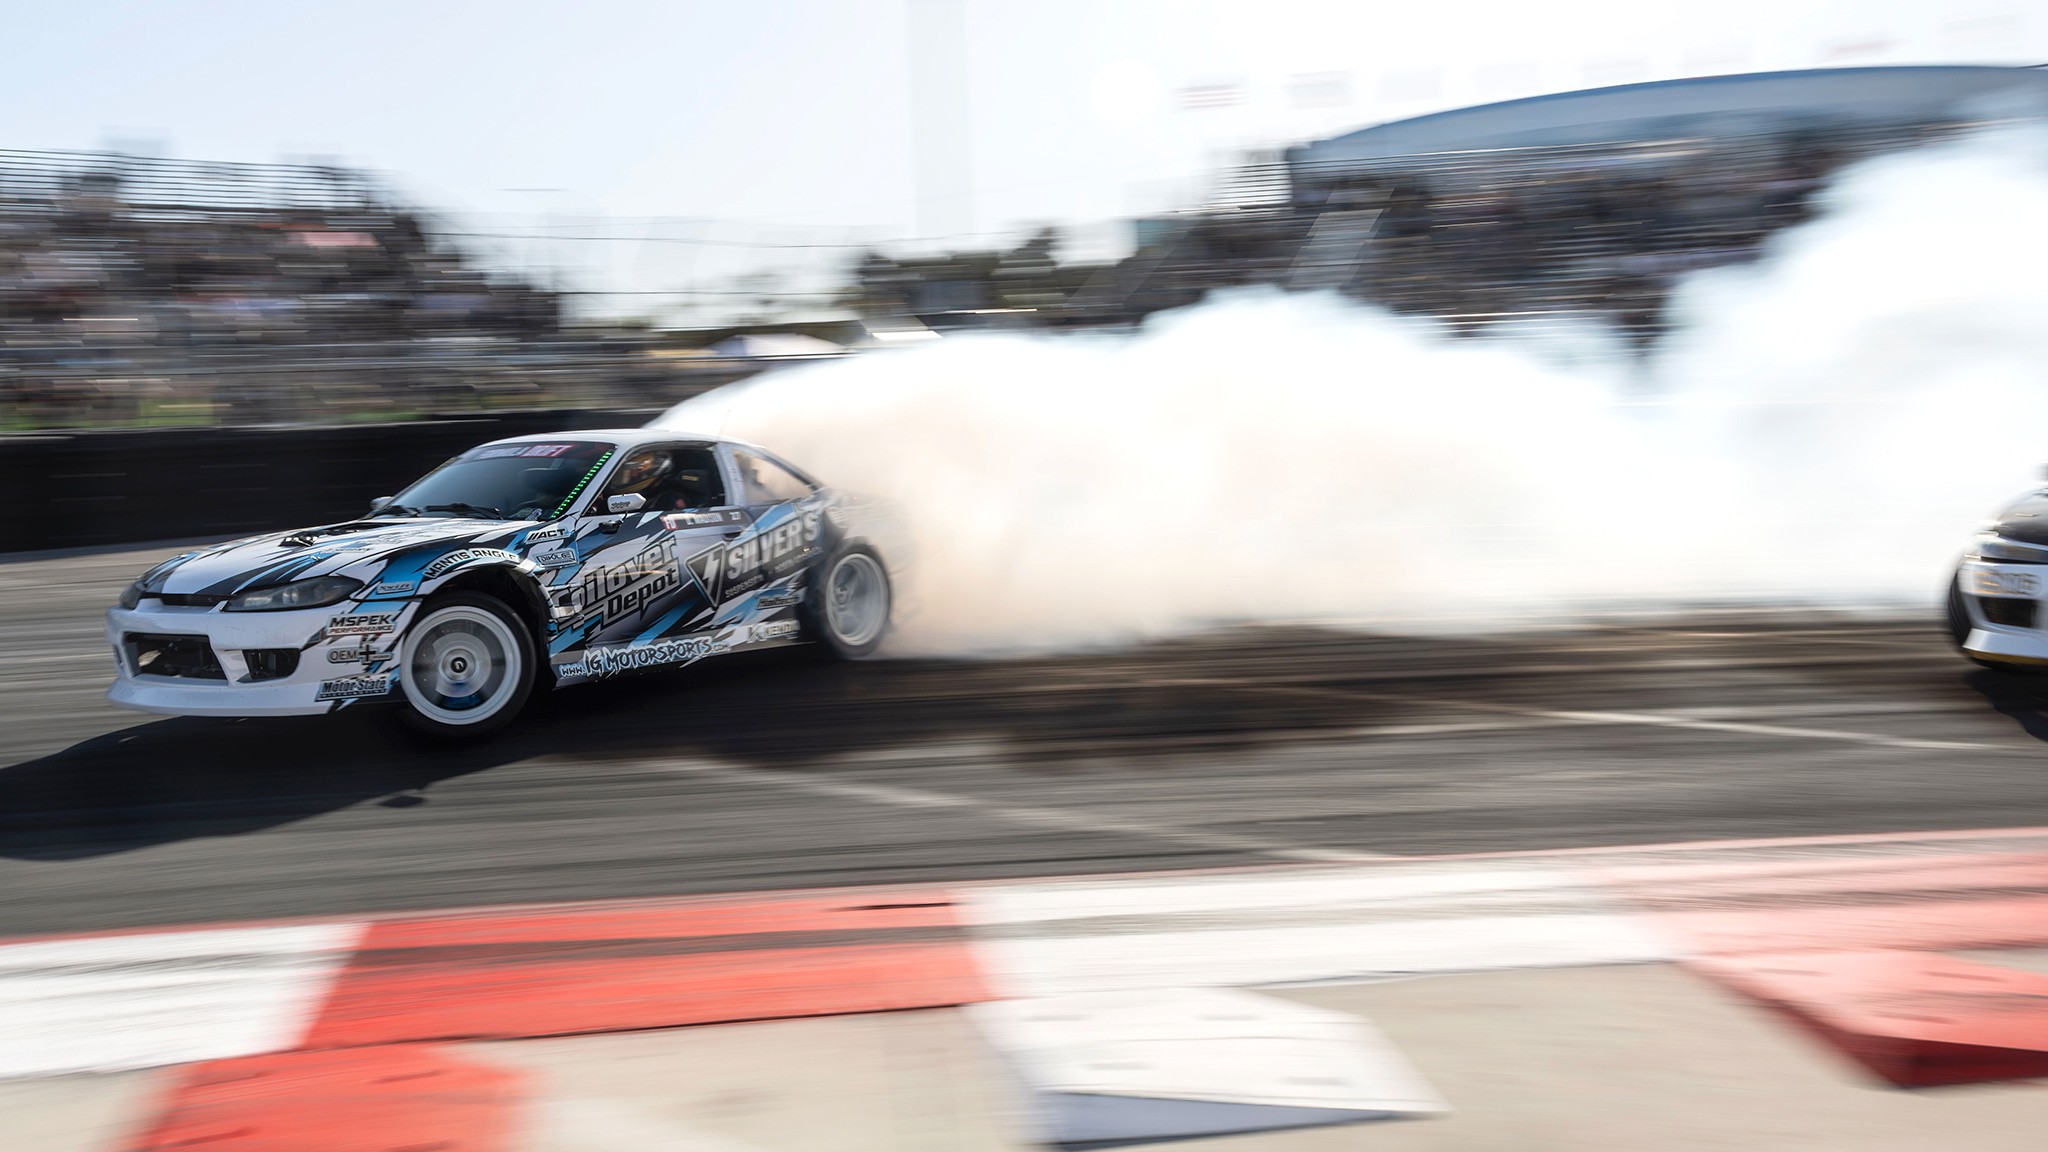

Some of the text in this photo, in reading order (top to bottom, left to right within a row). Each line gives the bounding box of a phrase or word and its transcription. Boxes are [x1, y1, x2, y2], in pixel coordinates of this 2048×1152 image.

[424, 549, 517, 577] MANTIS ANGLE
[550, 534, 678, 617] Coilover
[607, 567, 678, 621] Depot
[328, 614, 392, 628] MSPEK
[328, 625, 393, 635] PERFORMANCE
